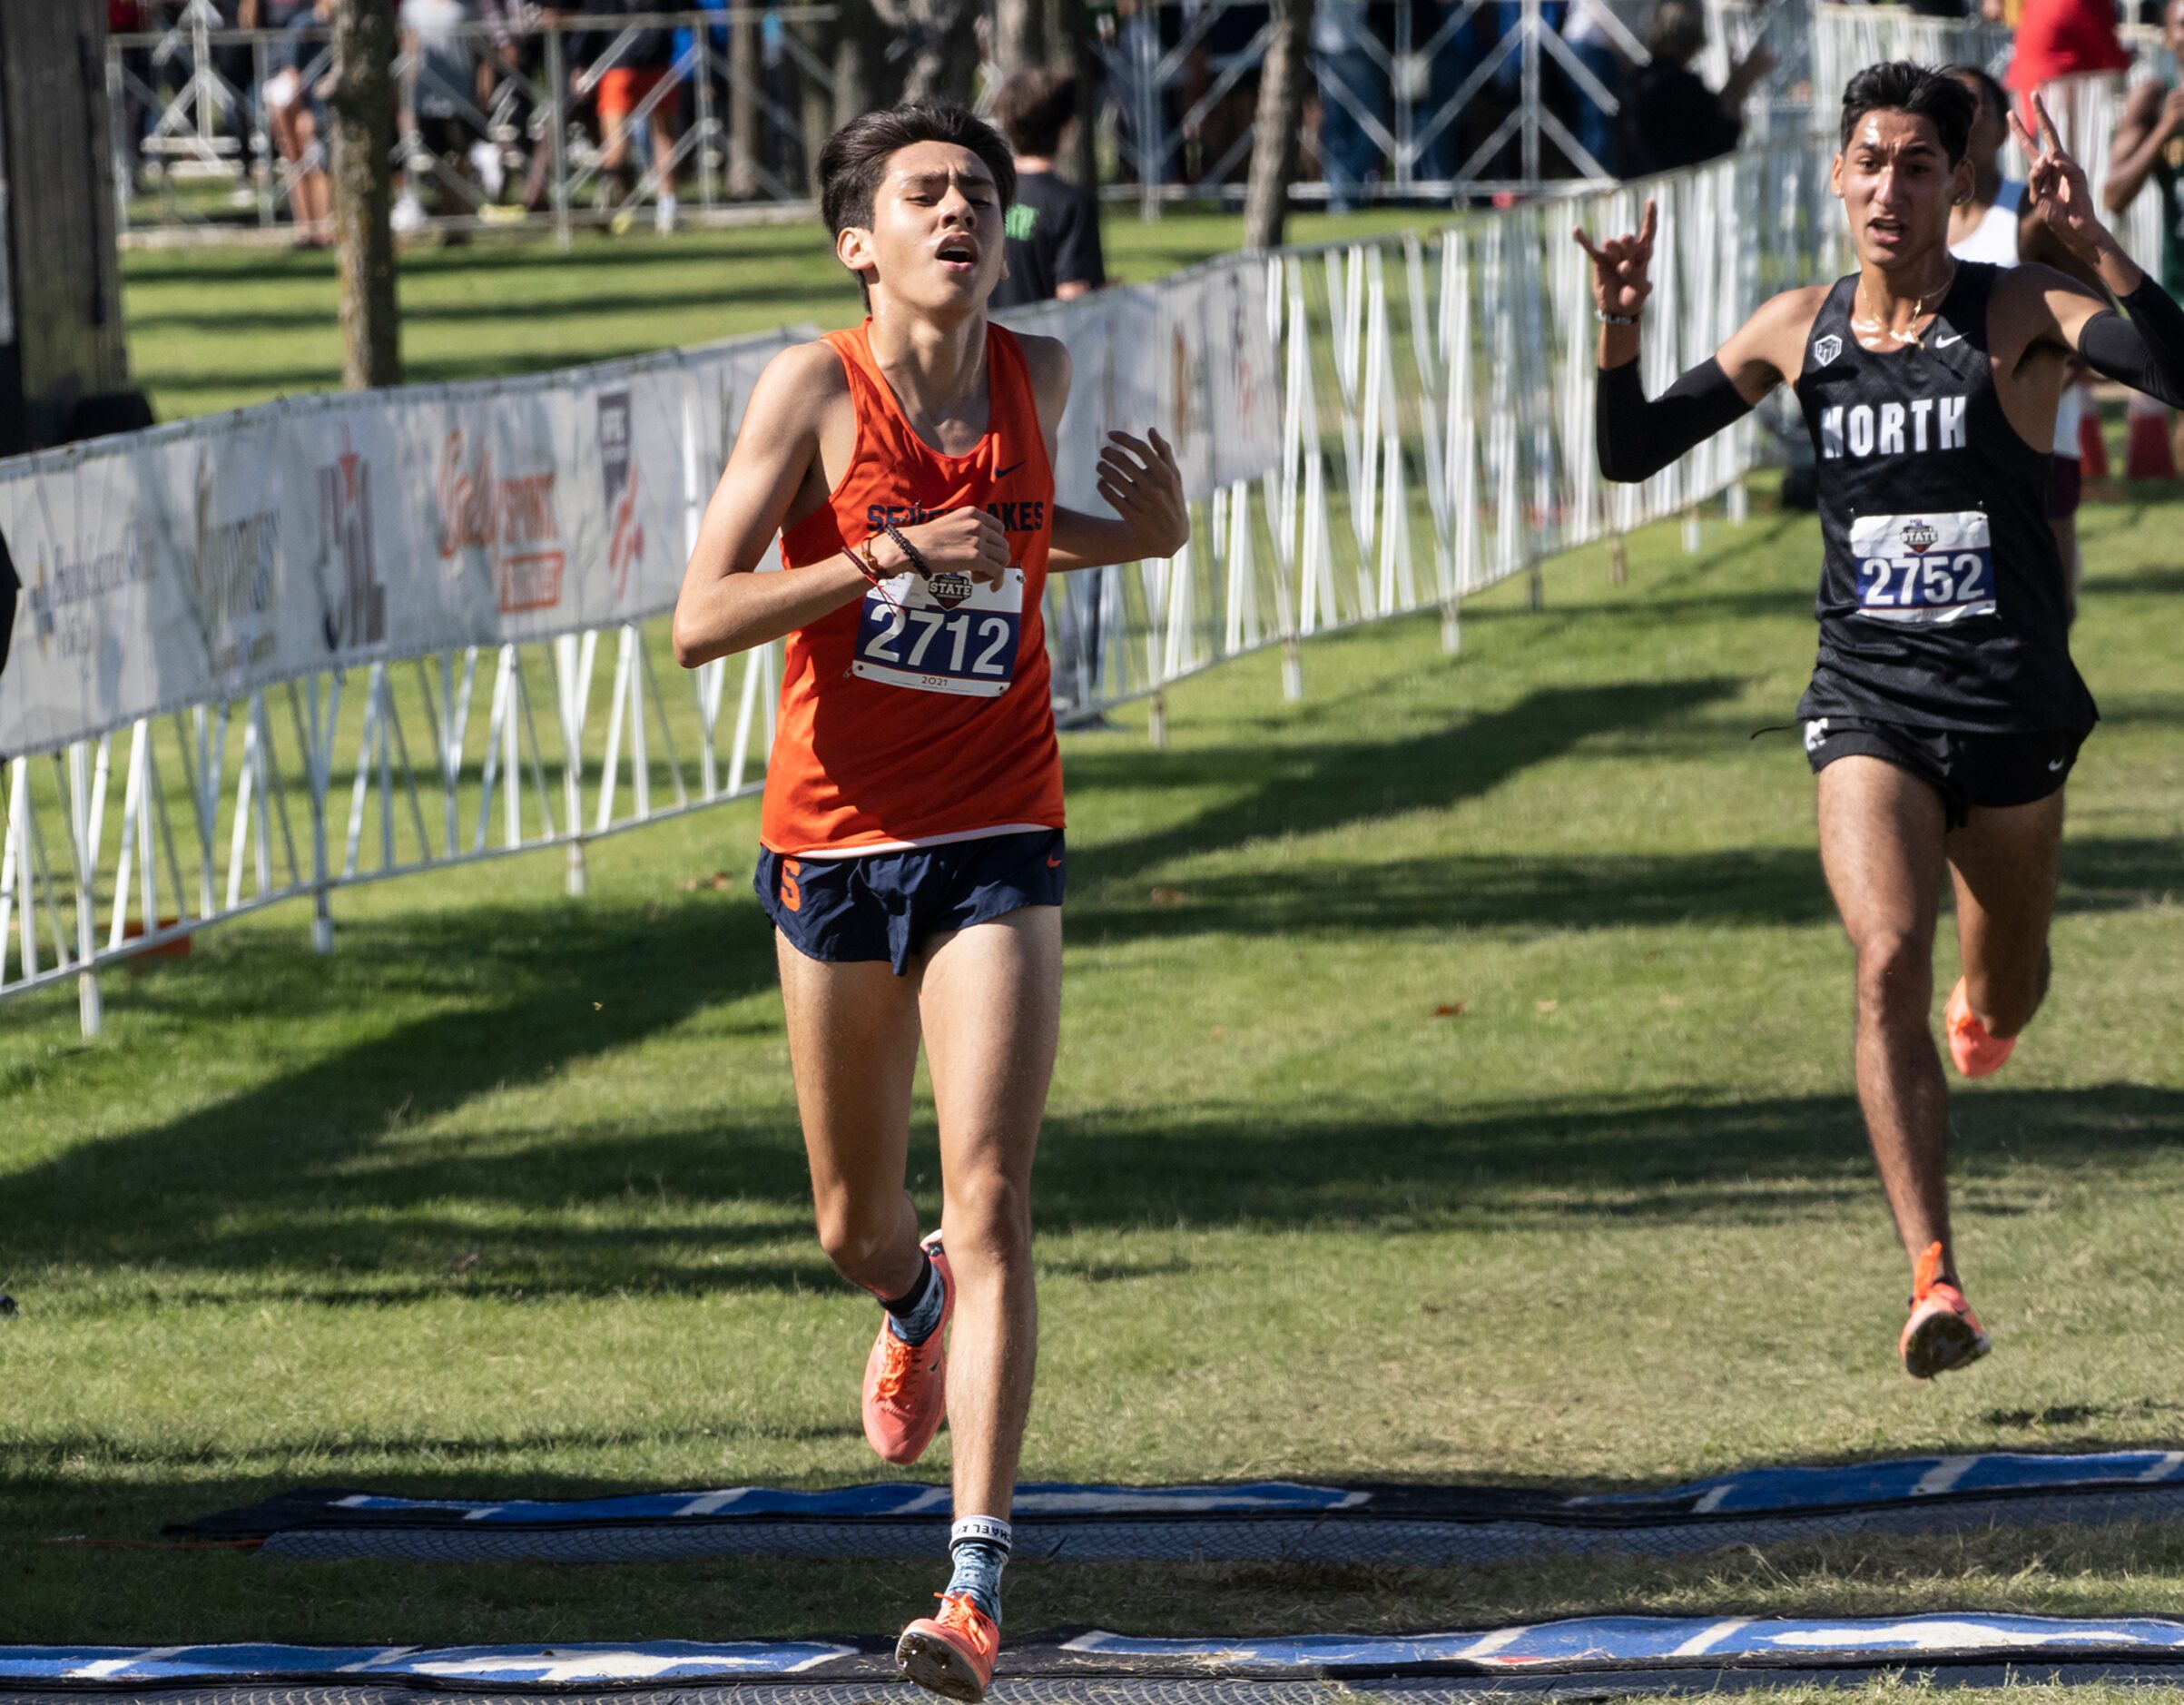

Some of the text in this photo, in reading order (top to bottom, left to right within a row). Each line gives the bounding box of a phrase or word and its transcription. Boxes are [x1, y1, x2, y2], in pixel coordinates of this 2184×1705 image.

[1822, 395, 1967, 459] NORTH
[929, 581, 972, 596] STATE
[1863, 553, 1985, 606] 2752
[864, 603, 1010, 675] 2712
[921, 675, 949, 687] 2021
[781, 859, 801, 913] S
